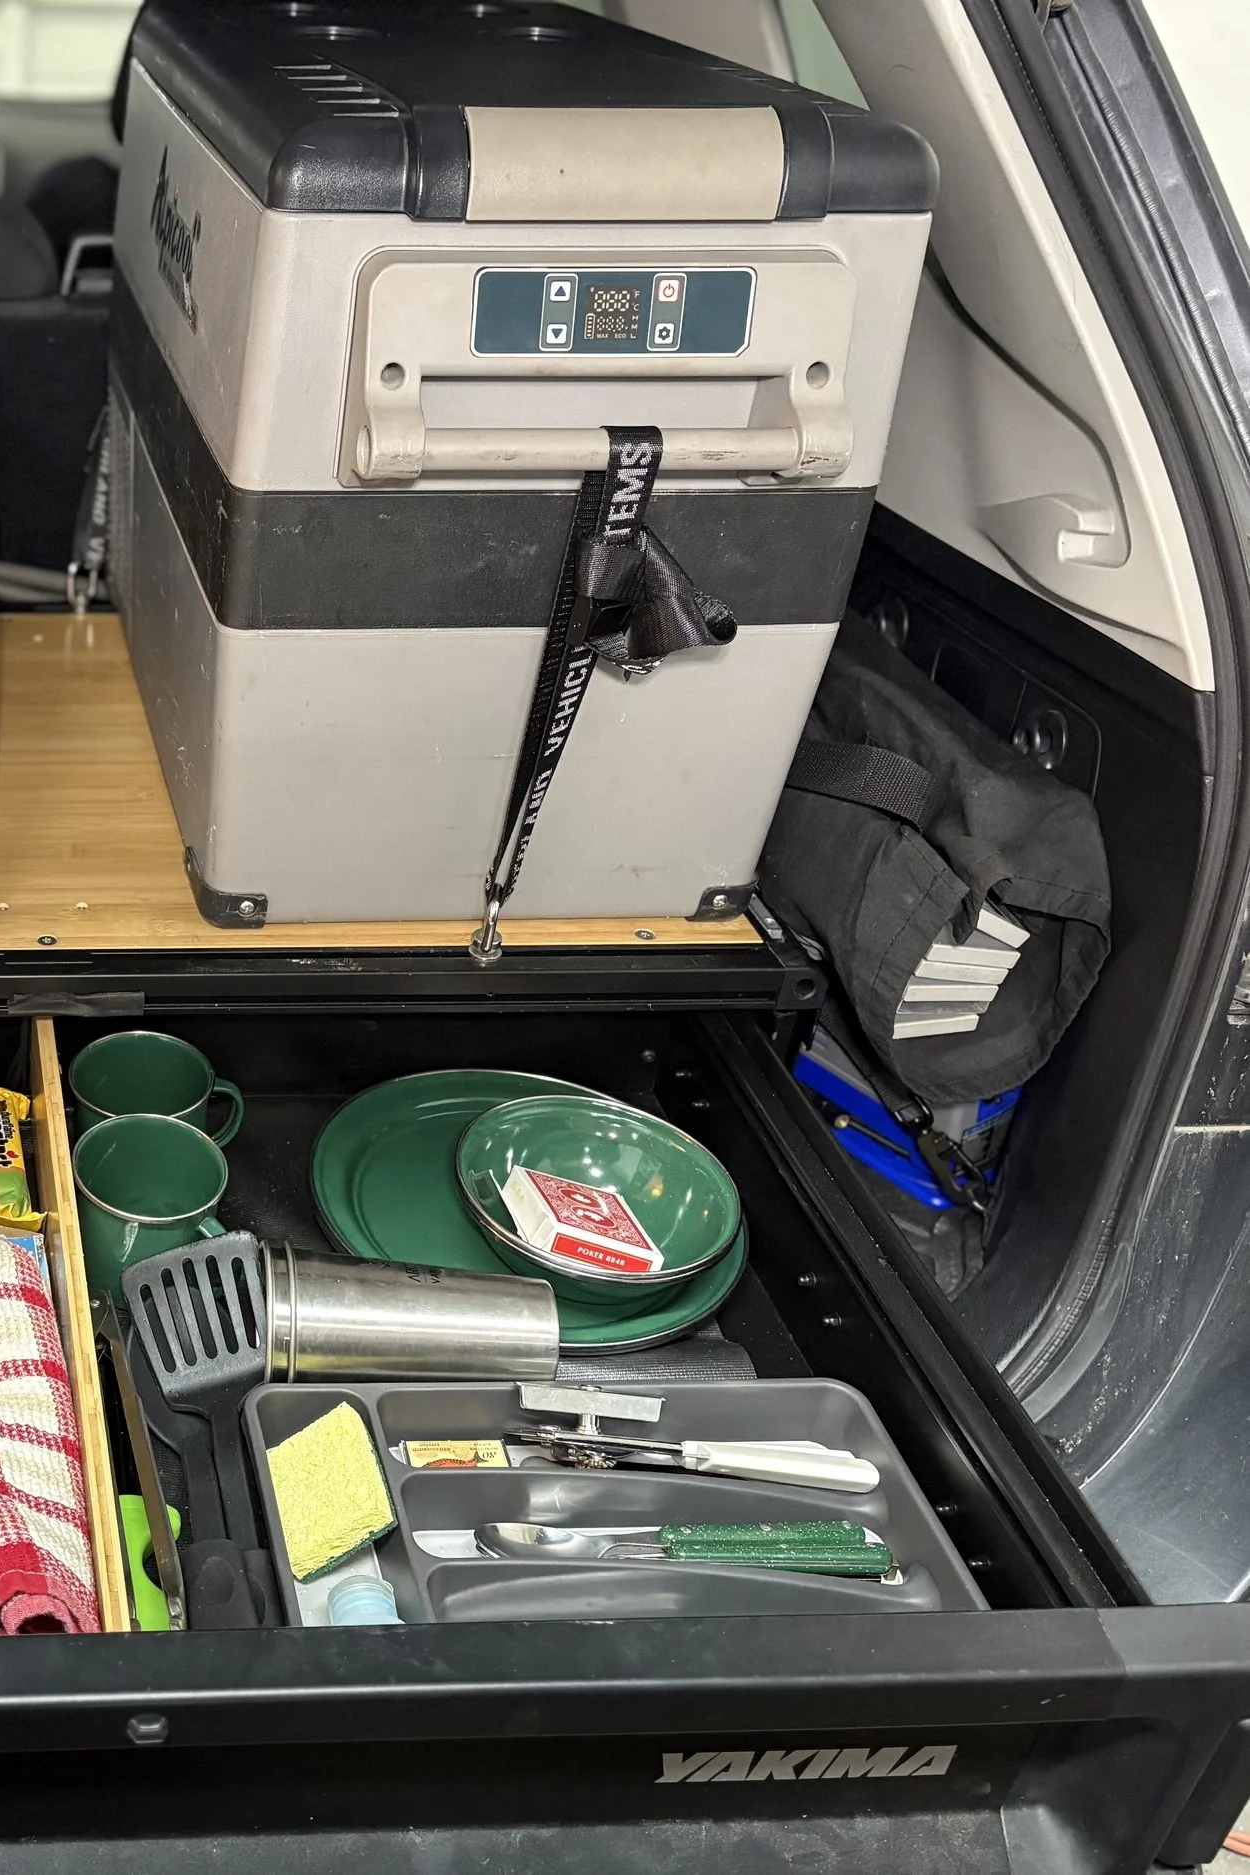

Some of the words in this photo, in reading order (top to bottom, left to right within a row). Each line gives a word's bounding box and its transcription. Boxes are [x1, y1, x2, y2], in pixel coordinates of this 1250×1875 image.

[544, 644, 594, 757] VEHICL
[576, 1246, 604, 1260] POKER
[605, 1254, 626, 1267] 8848
[654, 1745, 957, 1783] YAKIMA
